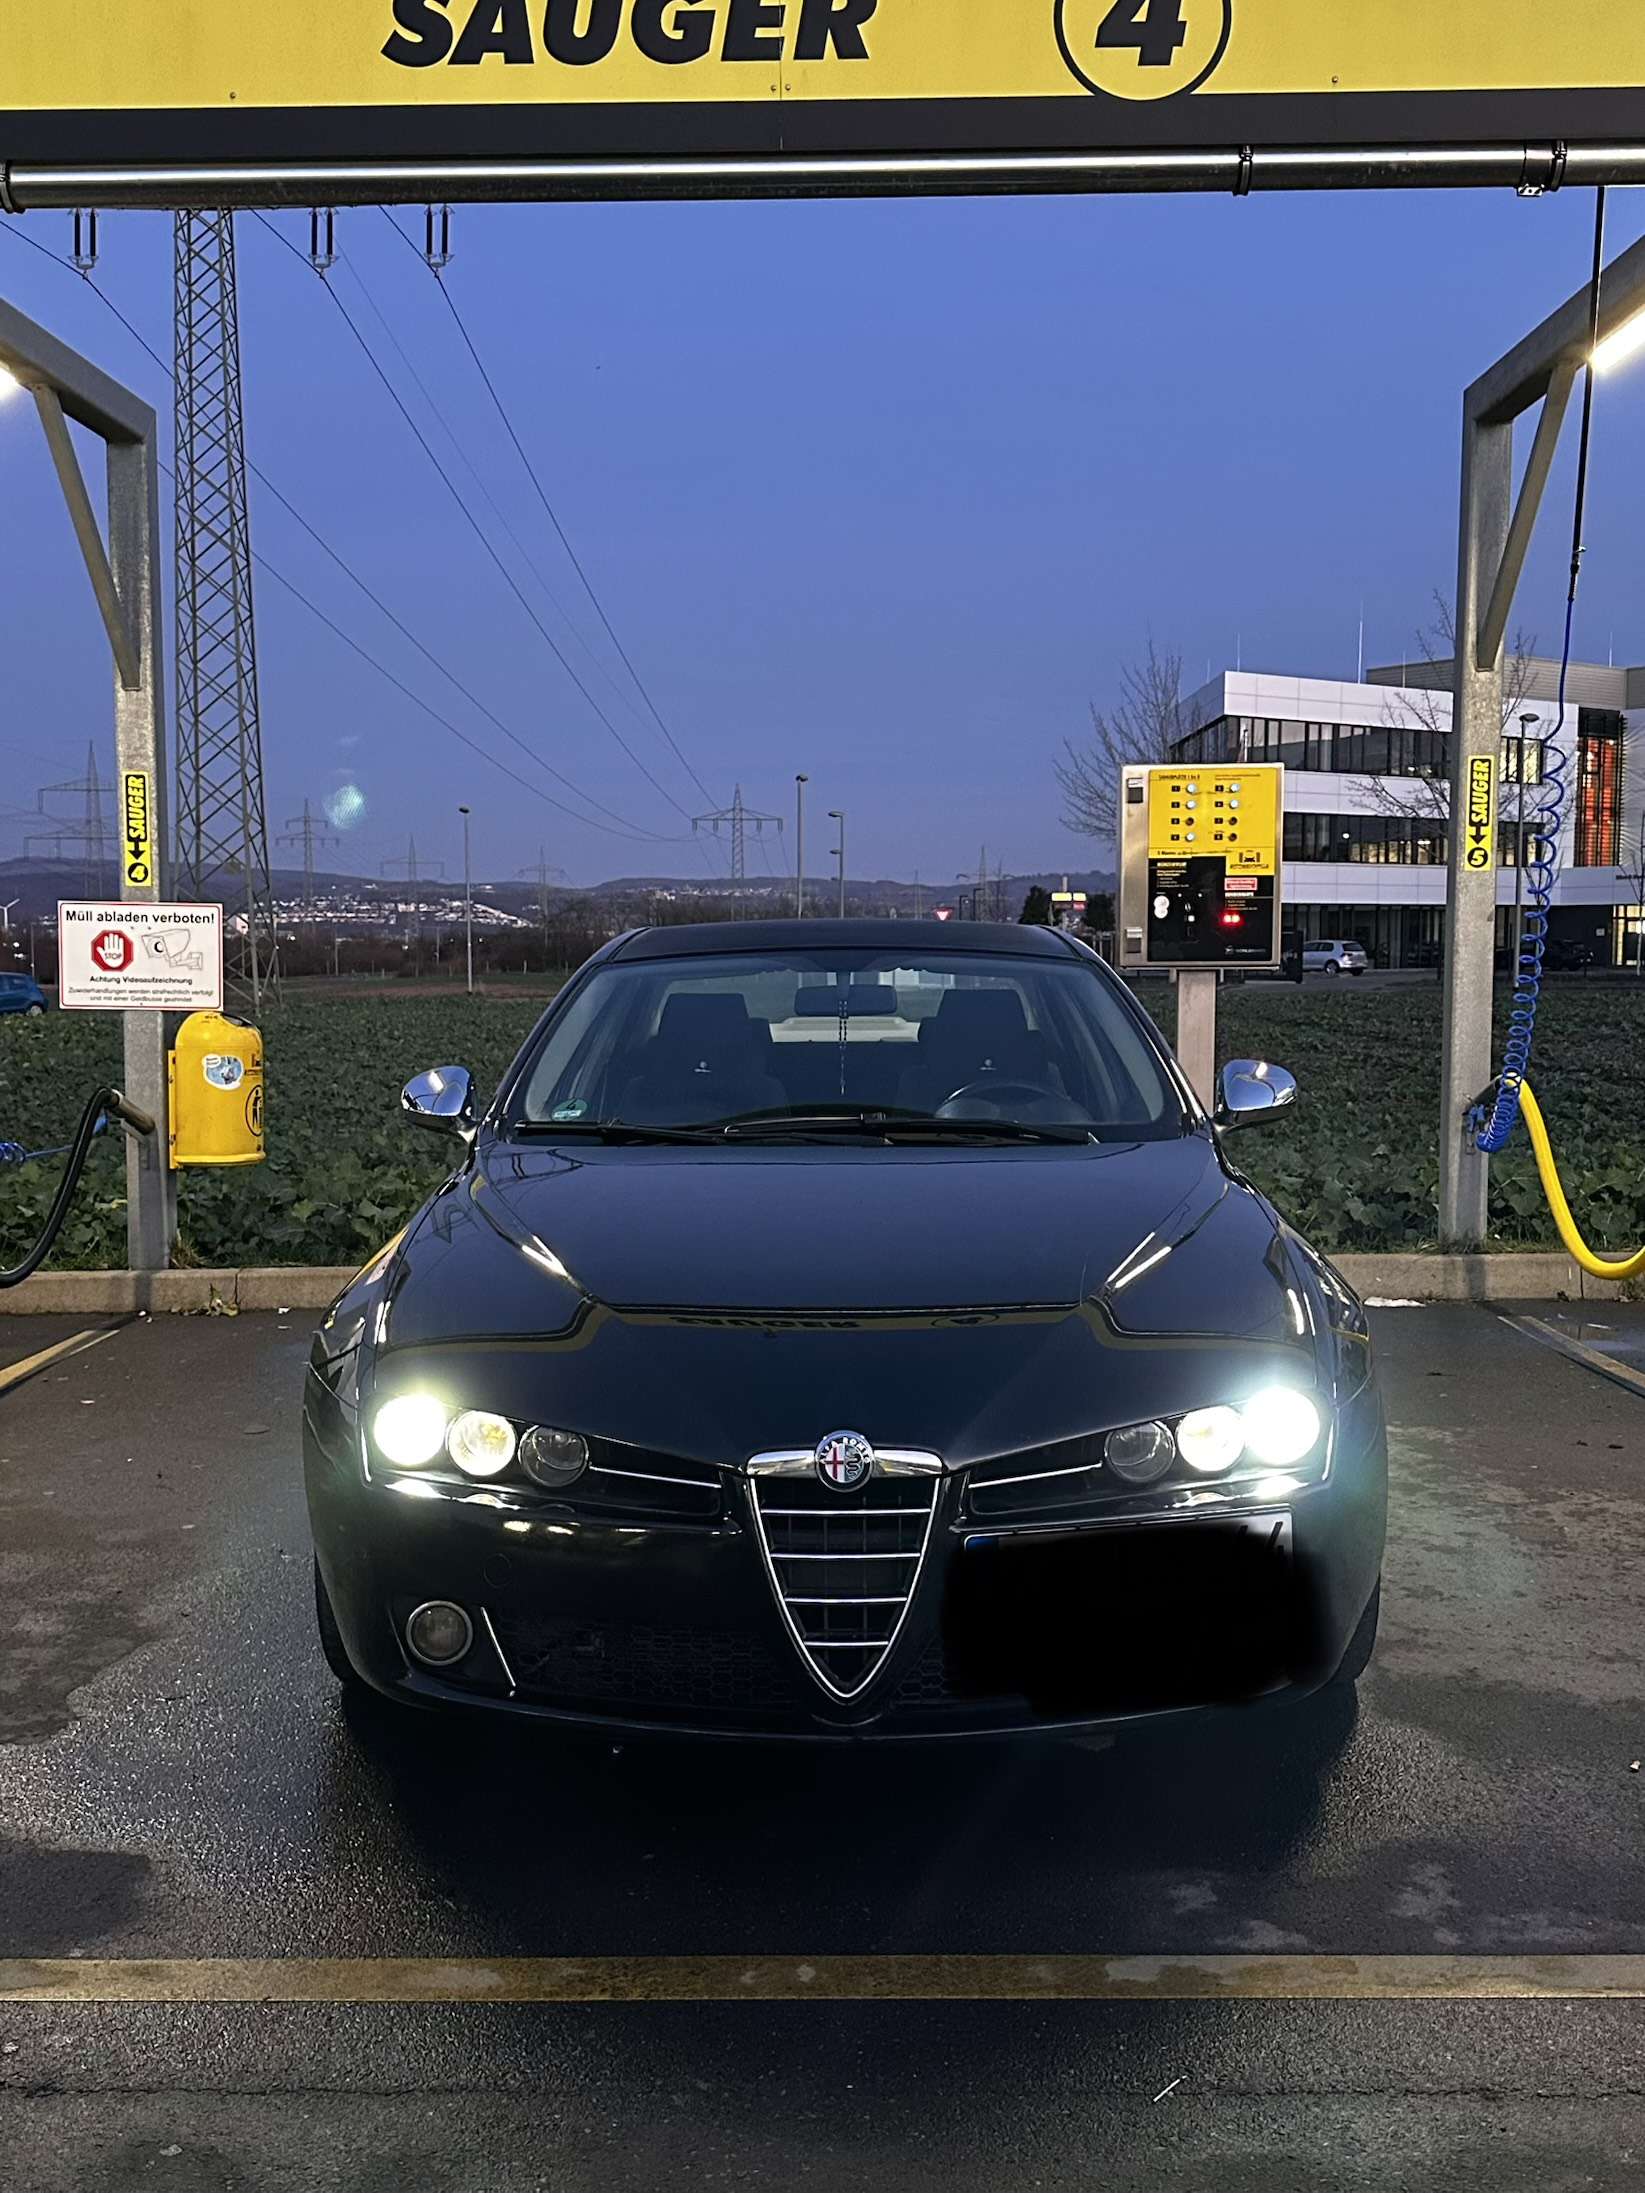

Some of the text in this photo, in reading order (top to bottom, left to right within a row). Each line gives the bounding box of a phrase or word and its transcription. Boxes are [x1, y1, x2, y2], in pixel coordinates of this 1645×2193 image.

[380, 0, 877, 68] SAUGER
[1095, 0, 1187, 66] 4
[1471, 759, 1489, 824] SAUGER
[127, 775, 146, 840] SAUGER
[1470, 850, 1485, 866] 5
[130, 865, 146, 881] 4
[65, 910, 215, 924] Müll abladen verboten!
[104, 952, 122, 960] STOP
[89, 975, 121, 984] Achtung
